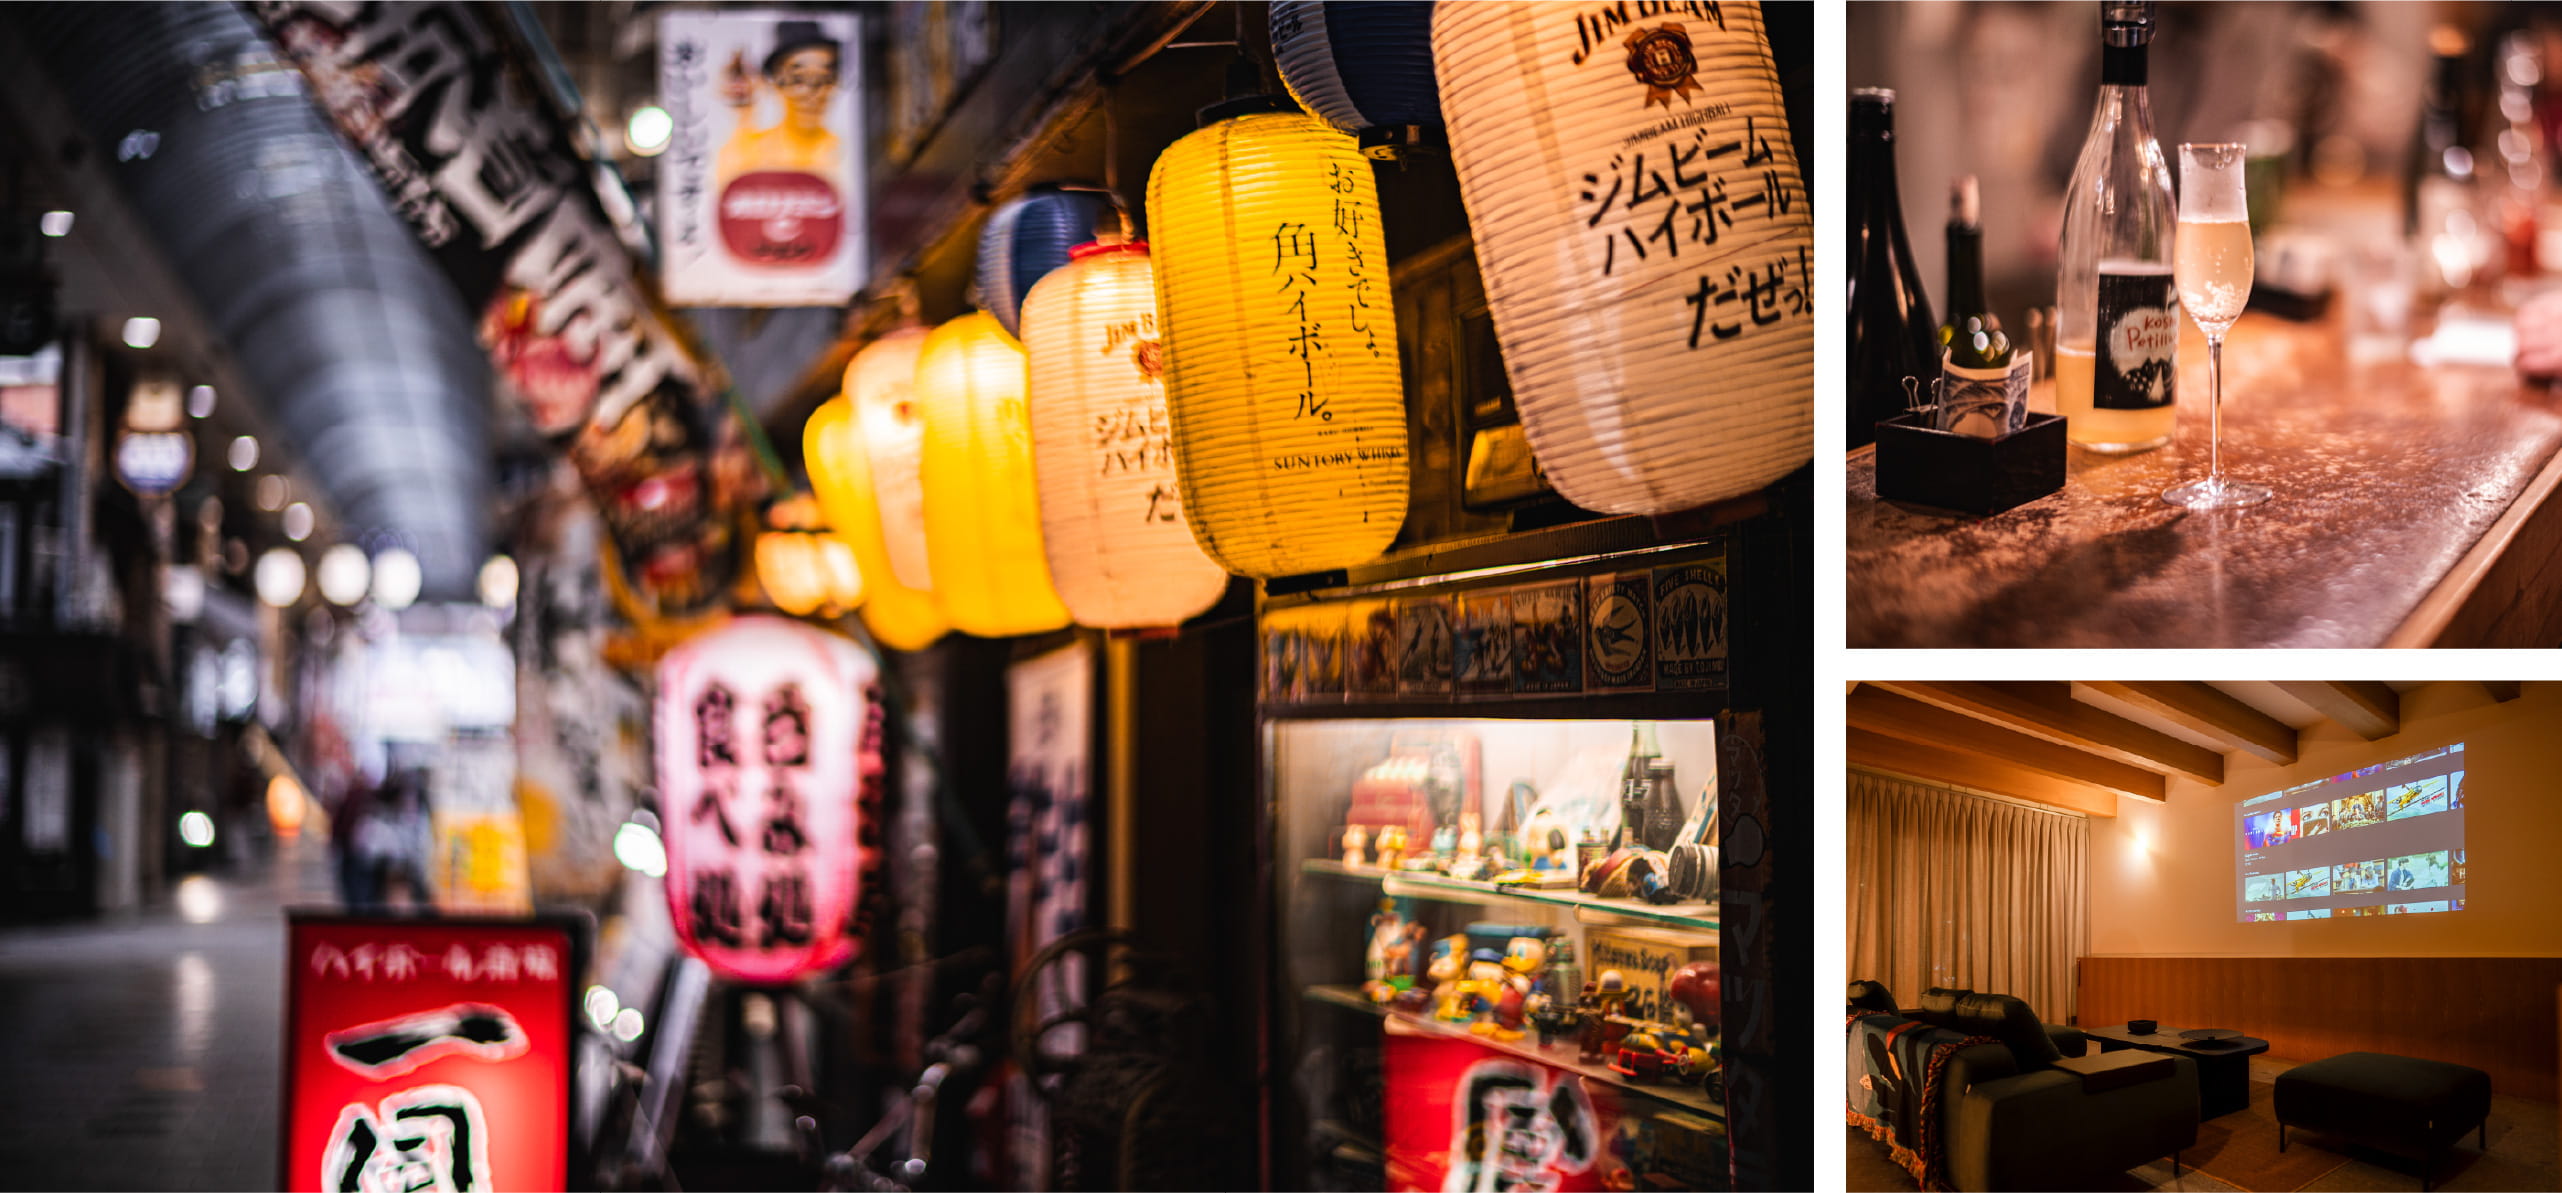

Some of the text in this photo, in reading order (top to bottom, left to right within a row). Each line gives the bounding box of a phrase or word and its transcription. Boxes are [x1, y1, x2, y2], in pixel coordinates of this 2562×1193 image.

[1573, 0, 1631, 65] JIM
[1580, 114, 1774, 228] ジムビーム
[1602, 168, 1792, 276] ハイボール
[1274, 451, 1352, 470] SUNTORY
